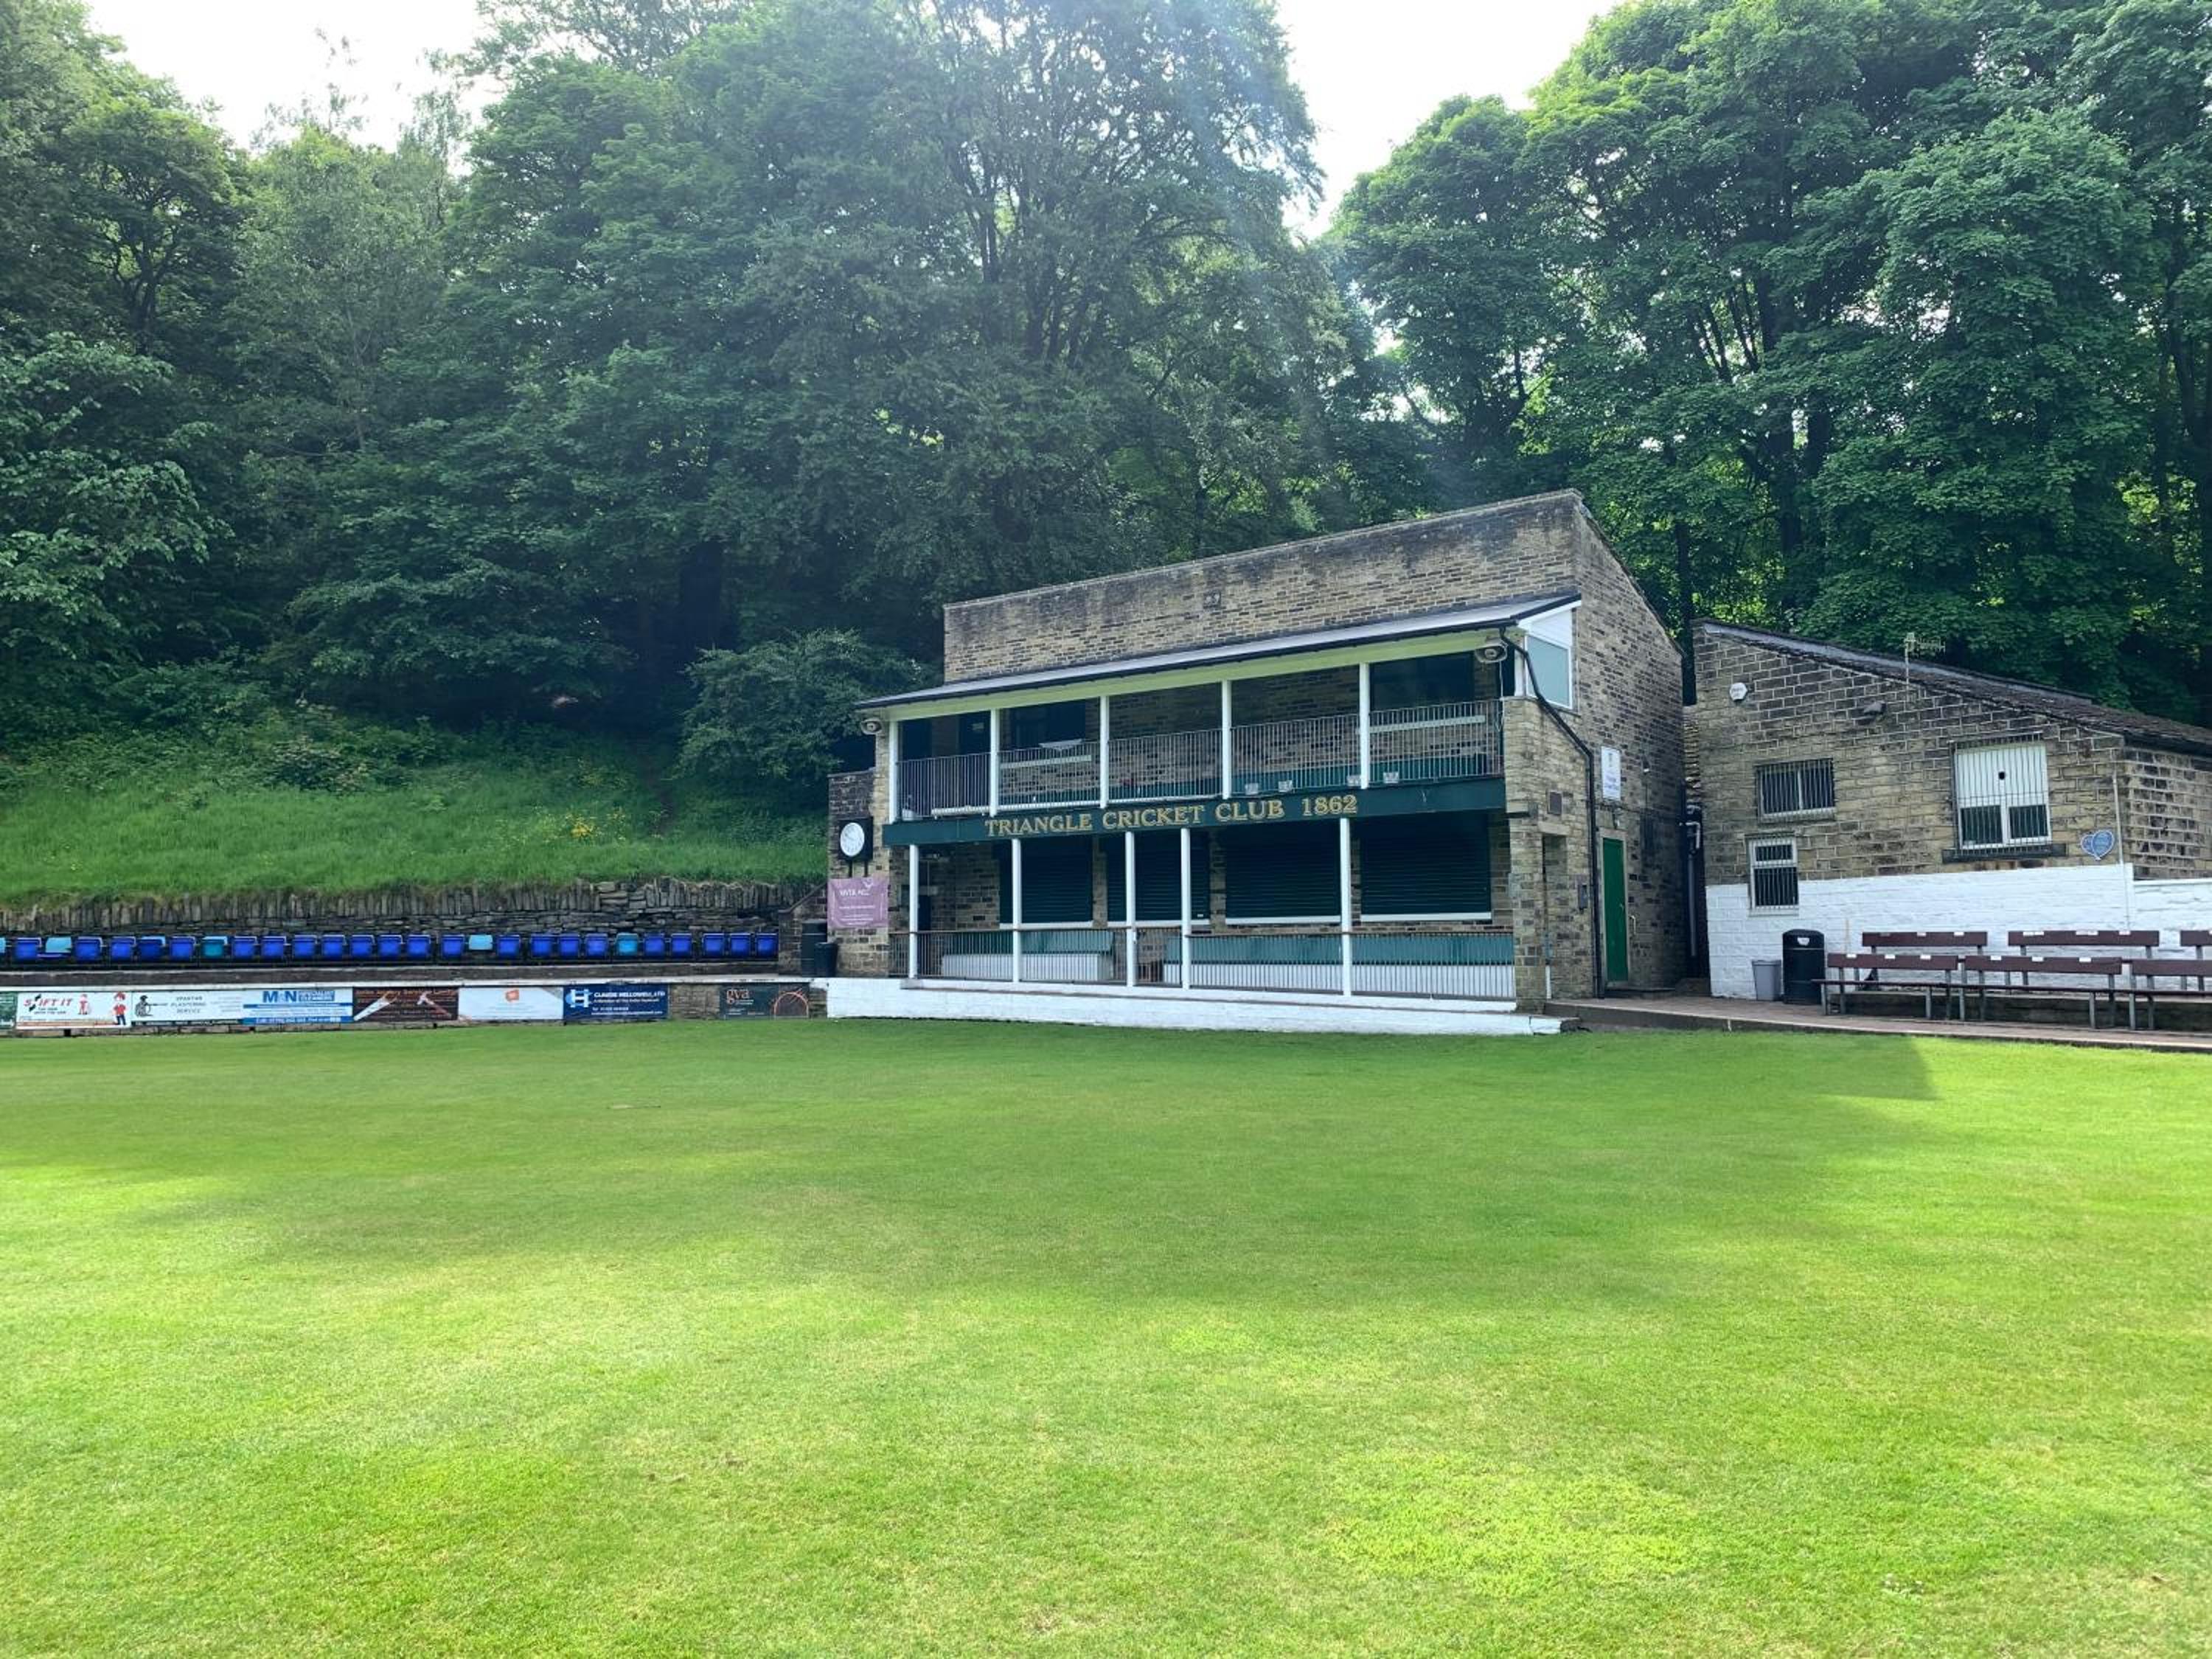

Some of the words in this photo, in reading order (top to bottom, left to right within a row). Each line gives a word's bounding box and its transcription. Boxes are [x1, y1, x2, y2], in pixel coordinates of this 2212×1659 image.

[984, 813, 1093, 837] TRIANGLE
[1102, 804, 1206, 829] CRICKET
[1215, 799, 1285, 822] CLUB
[1301, 794, 1358, 817] 1862
